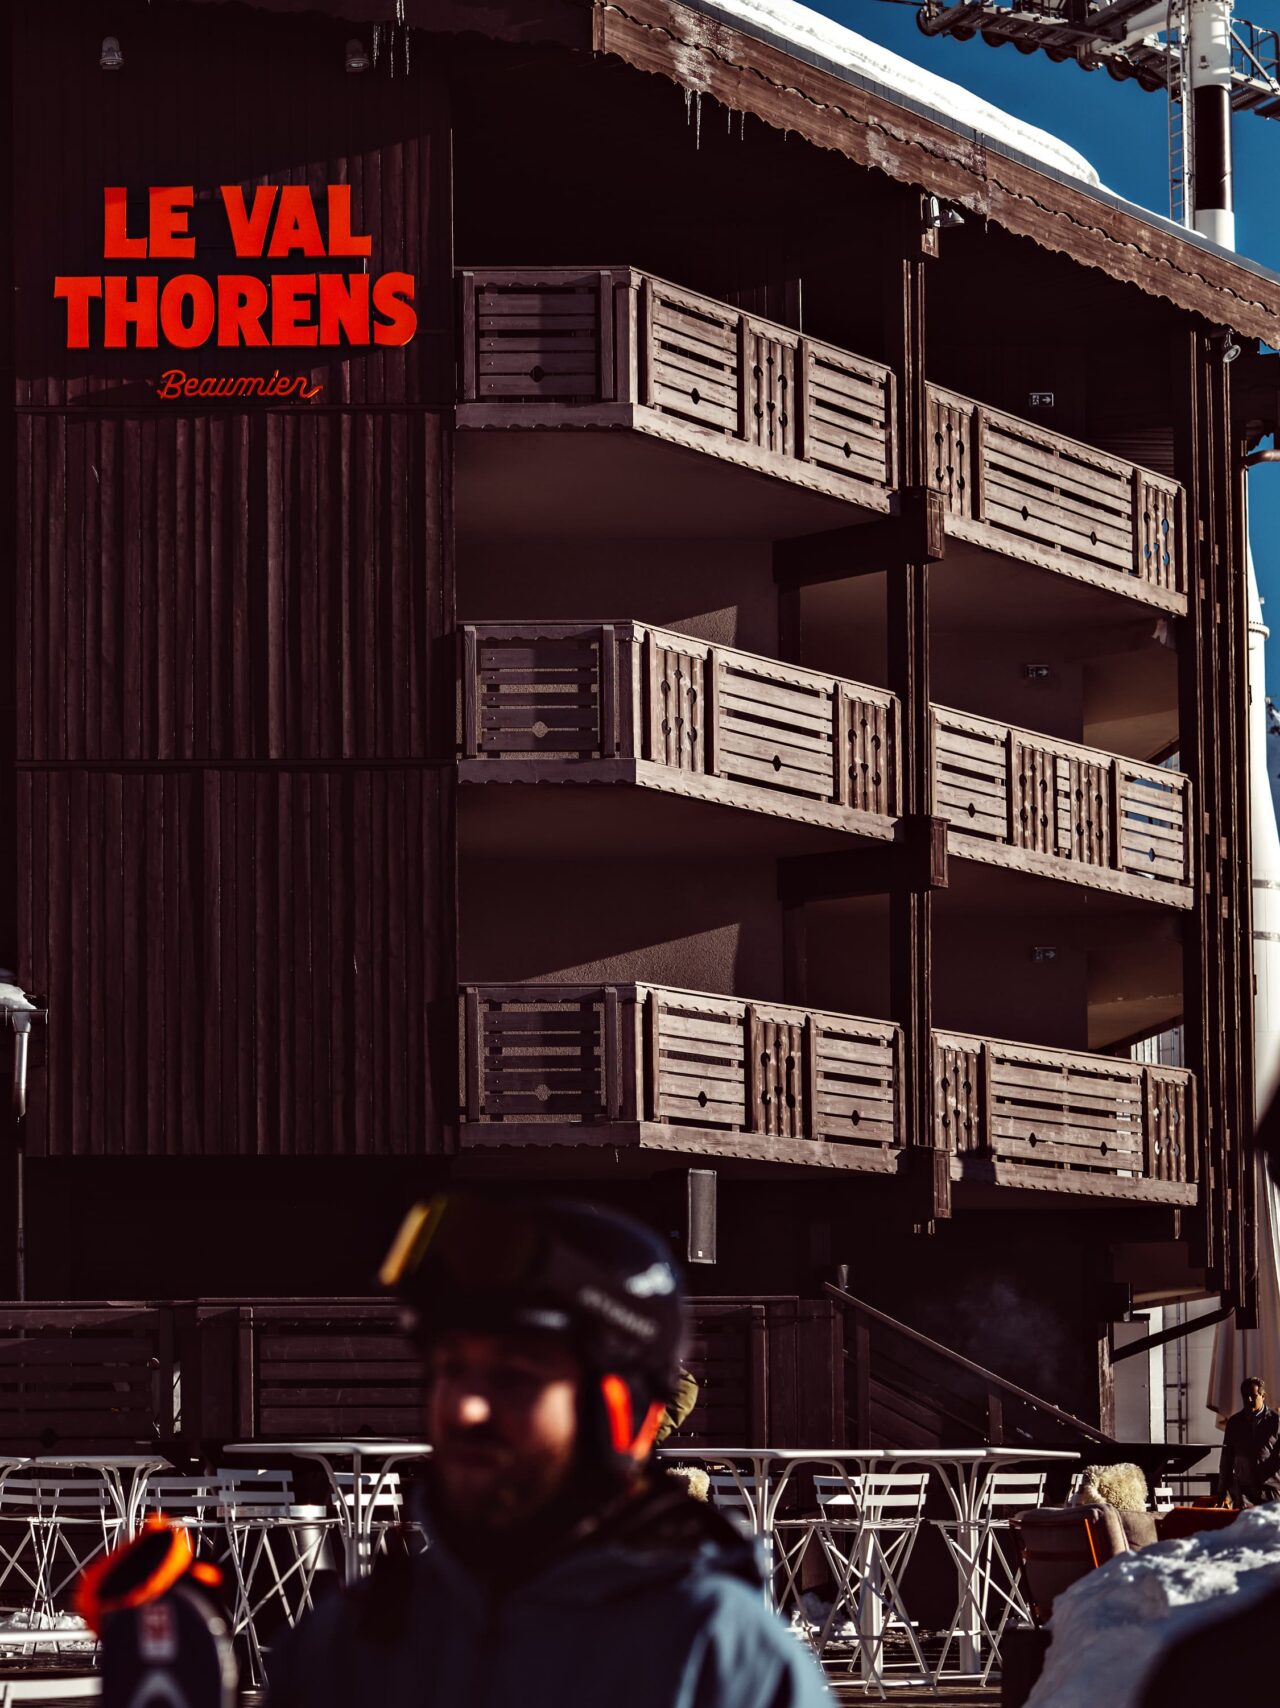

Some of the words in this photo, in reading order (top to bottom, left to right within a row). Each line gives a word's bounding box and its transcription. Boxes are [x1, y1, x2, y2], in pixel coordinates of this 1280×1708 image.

[103, 185, 196, 259] LE
[220, 184, 372, 258] VAL
[53, 271, 418, 349] THORENS
[156, 369, 323, 399] Beaumier
